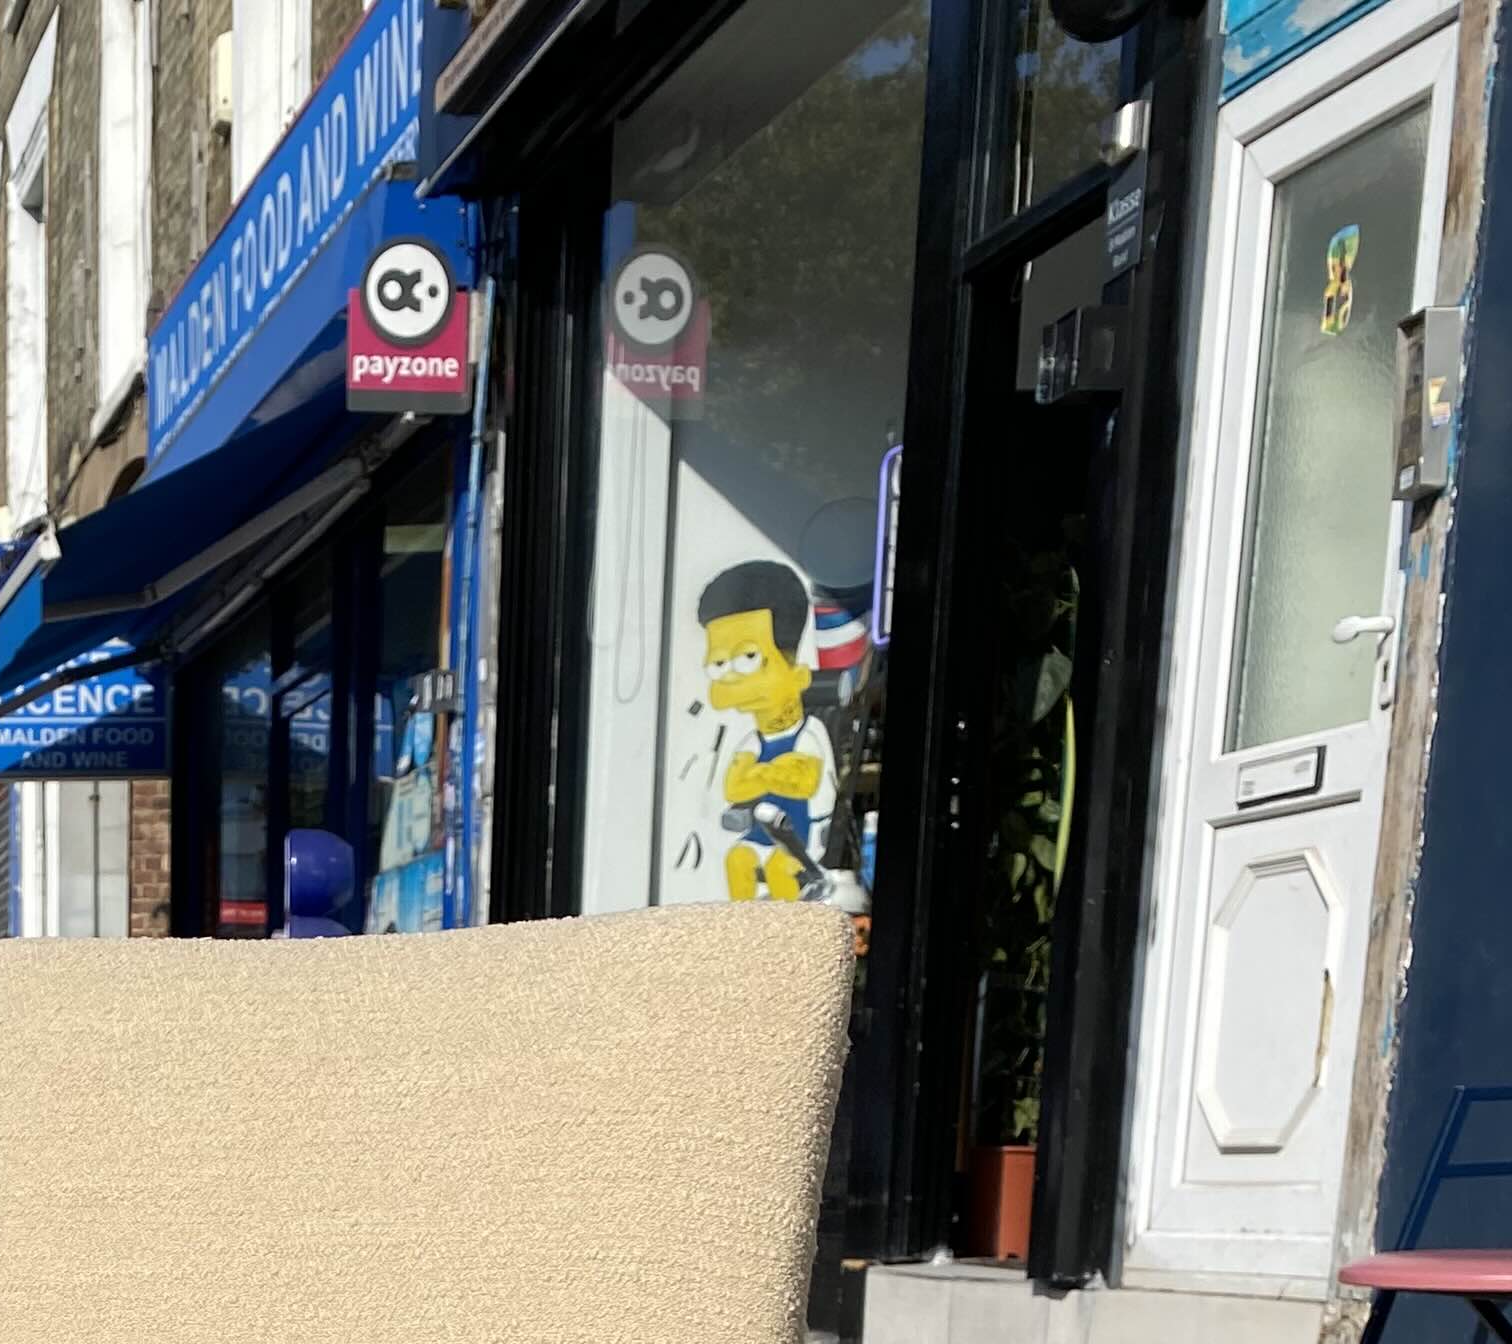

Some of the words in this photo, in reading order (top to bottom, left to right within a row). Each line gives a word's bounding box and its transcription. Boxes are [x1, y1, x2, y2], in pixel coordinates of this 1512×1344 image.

[155, 262, 226, 430] MALDEN
[230, 171, 293, 330] FOOD
[296, 93, 348, 248] AND
[354, 0, 424, 166] WINE
[352, 354, 460, 384] payzone
[15, 683, 155, 715] CENCE
[91, 727, 155, 745] FOOD
[21, 750, 67, 768] AND
[71, 751, 129, 768] WINE
